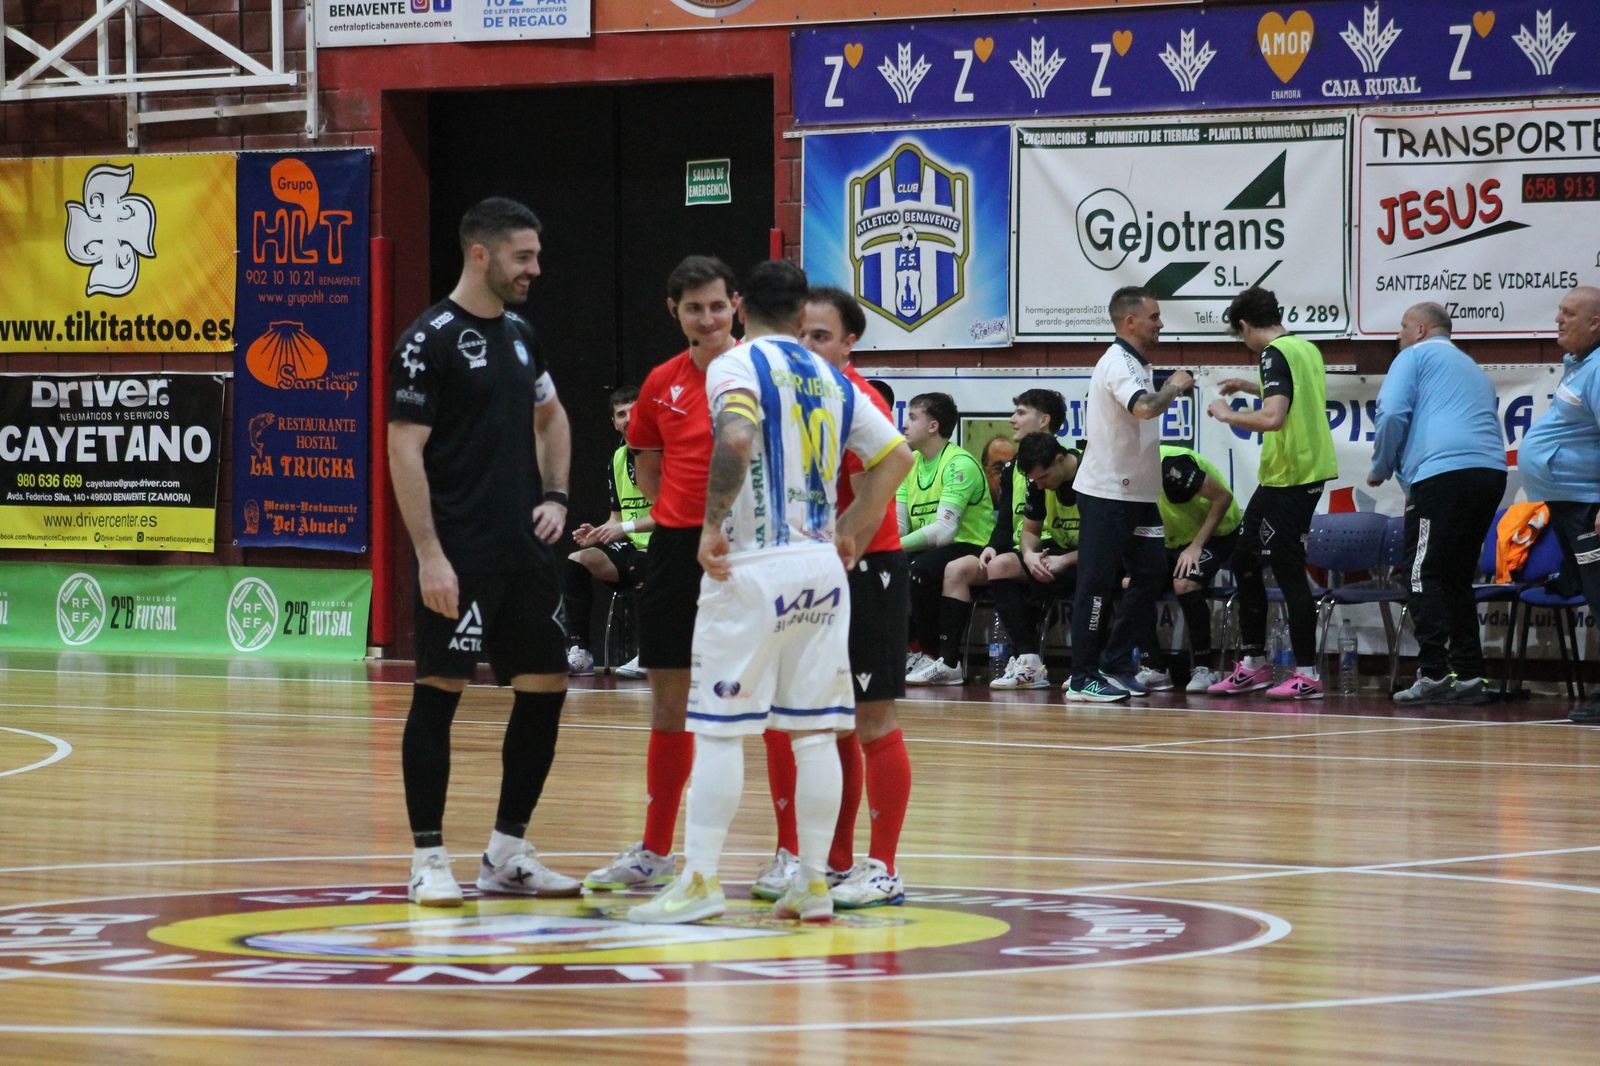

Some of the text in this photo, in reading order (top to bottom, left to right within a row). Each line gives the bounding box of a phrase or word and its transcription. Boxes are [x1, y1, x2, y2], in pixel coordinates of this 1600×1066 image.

[329, 2, 406, 17] BENAVENTE
[483, 14, 567, 28] DE REGALO
[1449, 24, 1473, 81] Z
[954, 50, 974, 102] Z
[1090, 43, 1112, 97] Z
[824, 55, 844, 107] Z
[1321, 77, 1421, 97] CAJA RURAL
[1271, 90, 1301, 100] ENAMORA
[1023, 132, 1087, 145] EXCAVACIONES
[1095, 129, 1150, 144] MOVIMIENTO
[1151, 129, 1162, 143] DE
[1163, 127, 1200, 142] TIERRAS
[1208, 126, 1240, 141] PLANTA
[1242, 126, 1253, 139] DE
[1304, 124, 1311, 137] Y
[277, 176, 313, 193] Grupo
[692, 167, 724, 182] SALIDA DE
[689, 183, 729, 197] EMERGENCIA
[897, 183, 919, 193] CLUB
[1524, 176, 1597, 200] 658 913
[1376, 178, 1503, 245] JESUS
[856, 211, 960, 235] ATLETICO BENAVENTE
[253, 208, 353, 264] HLT
[1085, 209, 1286, 263] Gejotrans
[246, 270, 361, 286] 902 10 10 21 BENAVENTE
[1214, 265, 1251, 288] S.L.
[1376, 269, 1578, 291] SANTIBAÑEZ DE VIDRIALES
[1305, 304, 1339, 323] 289
[278, 365, 358, 401] Santiago
[60, 411, 170, 421] NEUMÁTICOS Y SERVICIOS
[278, 417, 356, 432] RESTAURANTE
[0, 425, 212, 463] CAYETANO
[296, 436, 337, 450] HOSTAL
[791, 403, 836, 481] 10
[250, 455, 274, 476] LA
[17, 473, 36, 488] 980
[39, 474, 60, 488] 636
[63, 473, 83, 488] 699
[26, 492, 53, 501] Federico
[54, 493, 72, 502] Silva,
[73, 492, 86, 501] 140
[90, 492, 112, 501] 49600
[113, 493, 147, 501] BENAVENTE
[148, 492, 191, 503] (ZAMORA)
[43, 512, 158, 528] www.drivercenter.es
[134, 604, 176, 631] FUTSAL
[309, 610, 352, 637] FUTSAL
